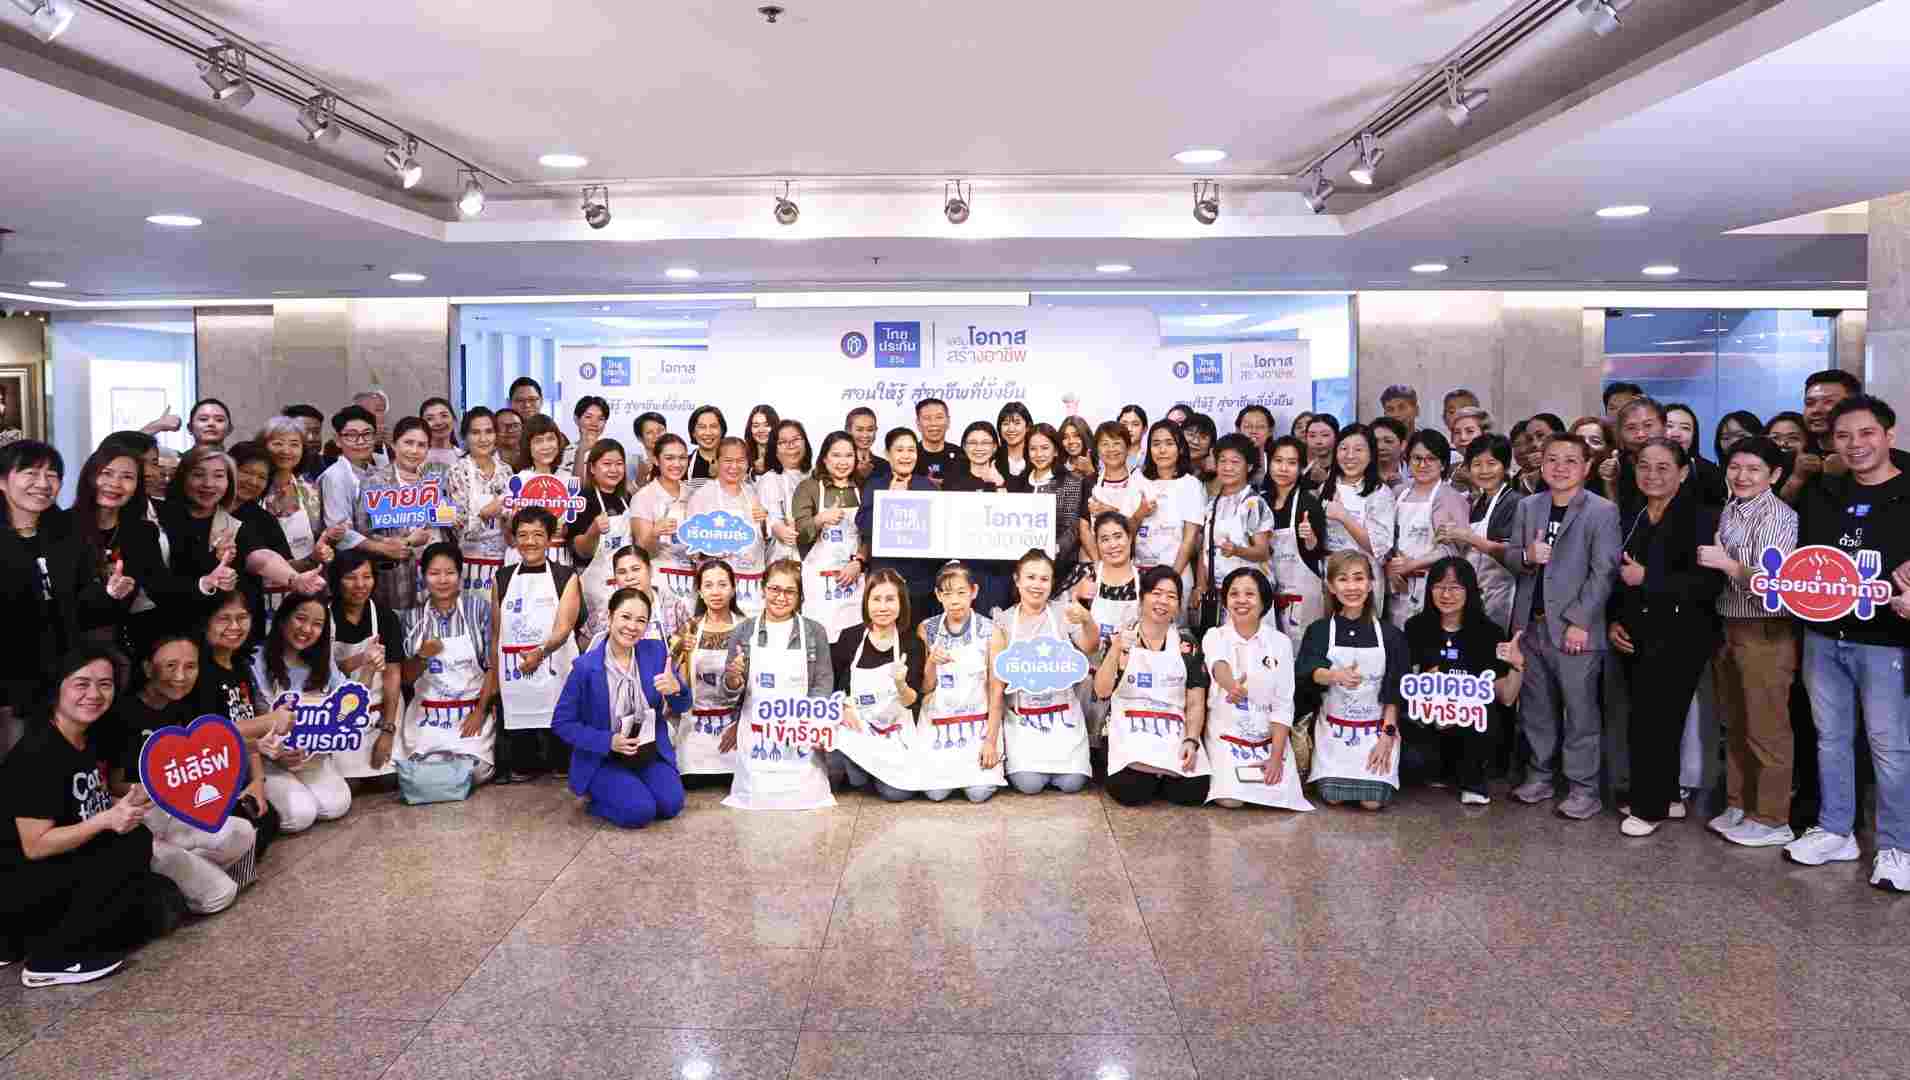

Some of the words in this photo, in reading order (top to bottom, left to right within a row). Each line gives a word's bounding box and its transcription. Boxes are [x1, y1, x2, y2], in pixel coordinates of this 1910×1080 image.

[366, 479, 438, 508] ขายดี
[1403, 672, 1493, 700] ออเดอร์
[758, 693, 843, 720] ออเดอร์
[1412, 697, 1483, 729] เข้ารัวๆ
[766, 719, 833, 747] เข้ารัวๆ
